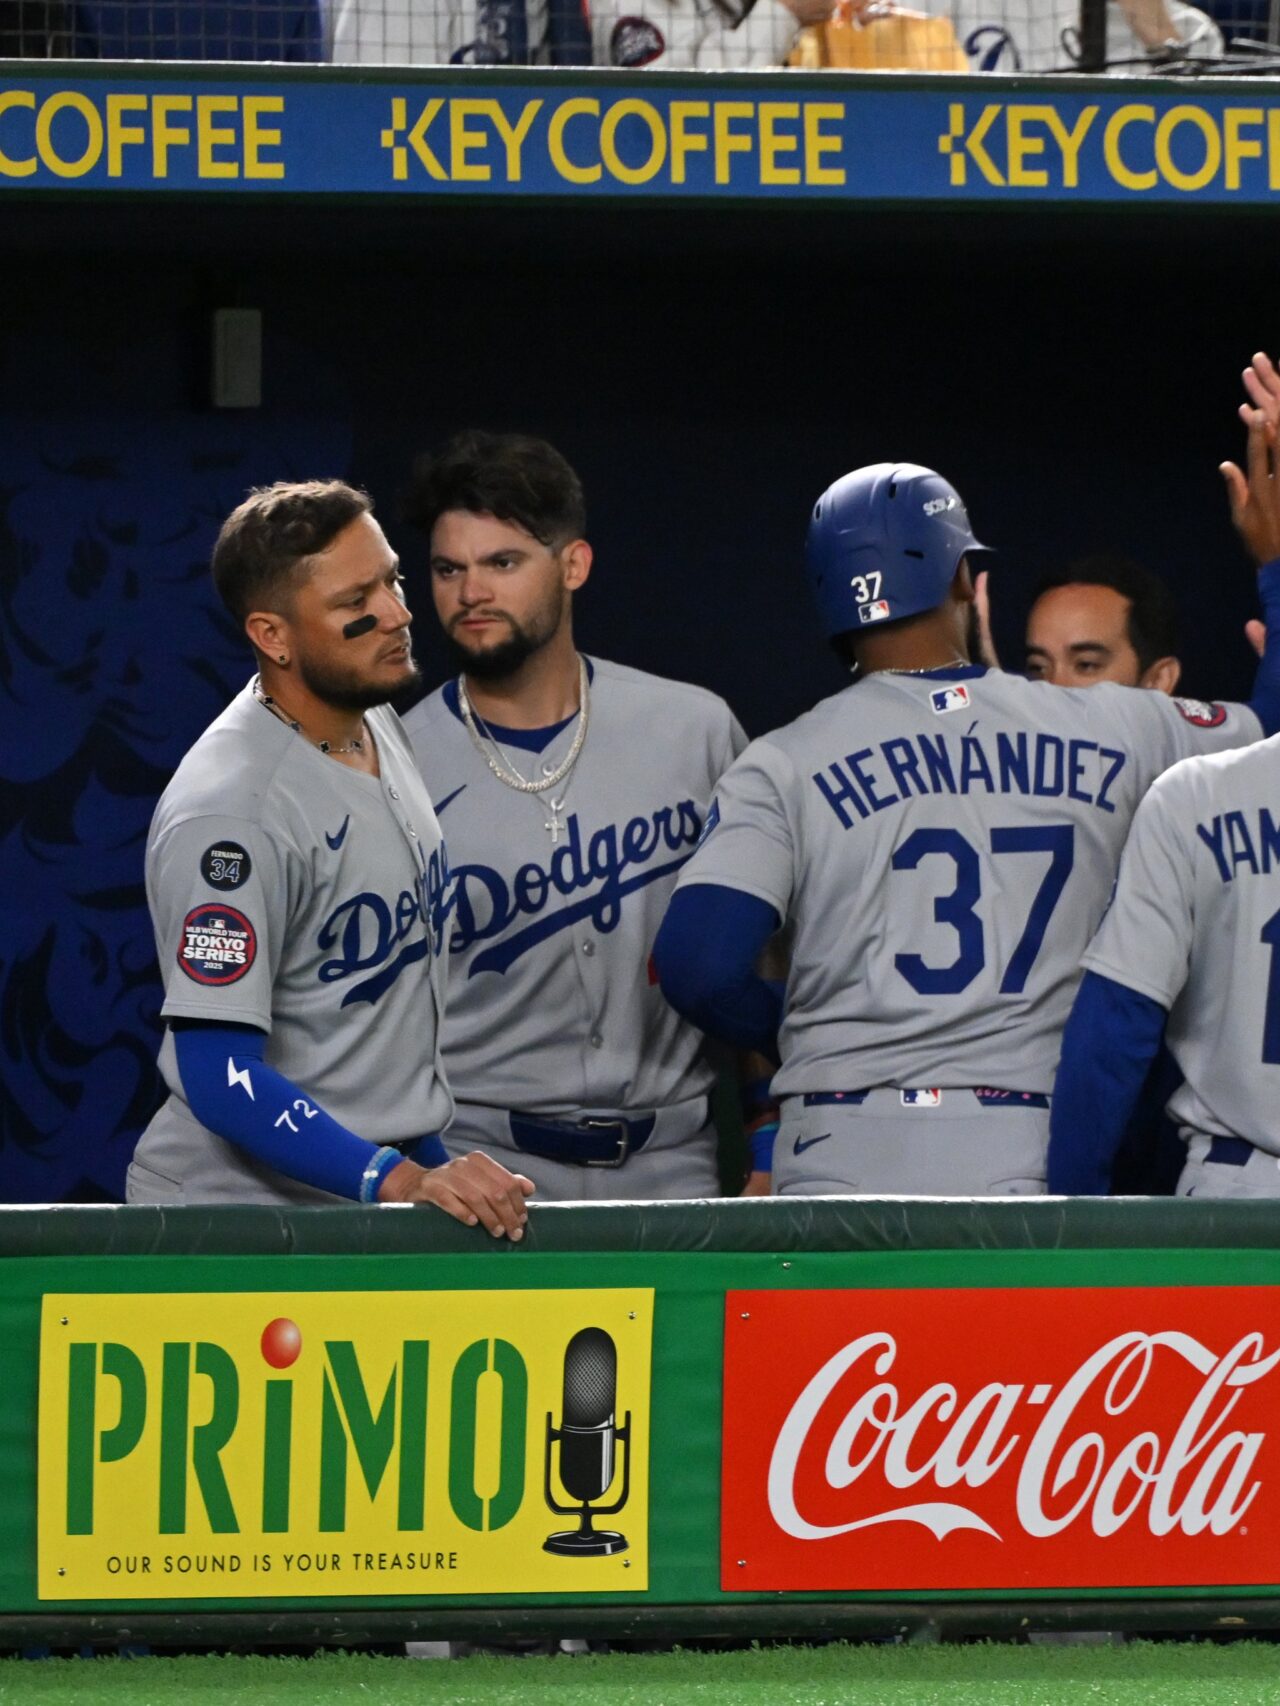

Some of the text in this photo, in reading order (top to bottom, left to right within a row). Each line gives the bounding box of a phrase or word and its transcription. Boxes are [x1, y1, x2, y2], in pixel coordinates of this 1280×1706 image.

[850, 570, 882, 605] 37
[812, 719, 1127, 831] HERNÁNDEZ
[210, 849, 244, 861] FERNANDO
[209, 858, 241, 883] 34
[446, 798, 702, 970] Dodgers
[891, 824, 1076, 996] 37
[185, 934, 246, 951] TOKYO
[200, 926, 228, 937] WORLD
[227, 928, 248, 939] TOUR
[182, 947, 247, 964] SERIES
[203, 961, 224, 970] 2025
[273, 1098, 319, 1133] 72
[106, 1551, 459, 1575] OUR SOUND IS YOUR TREASURE
